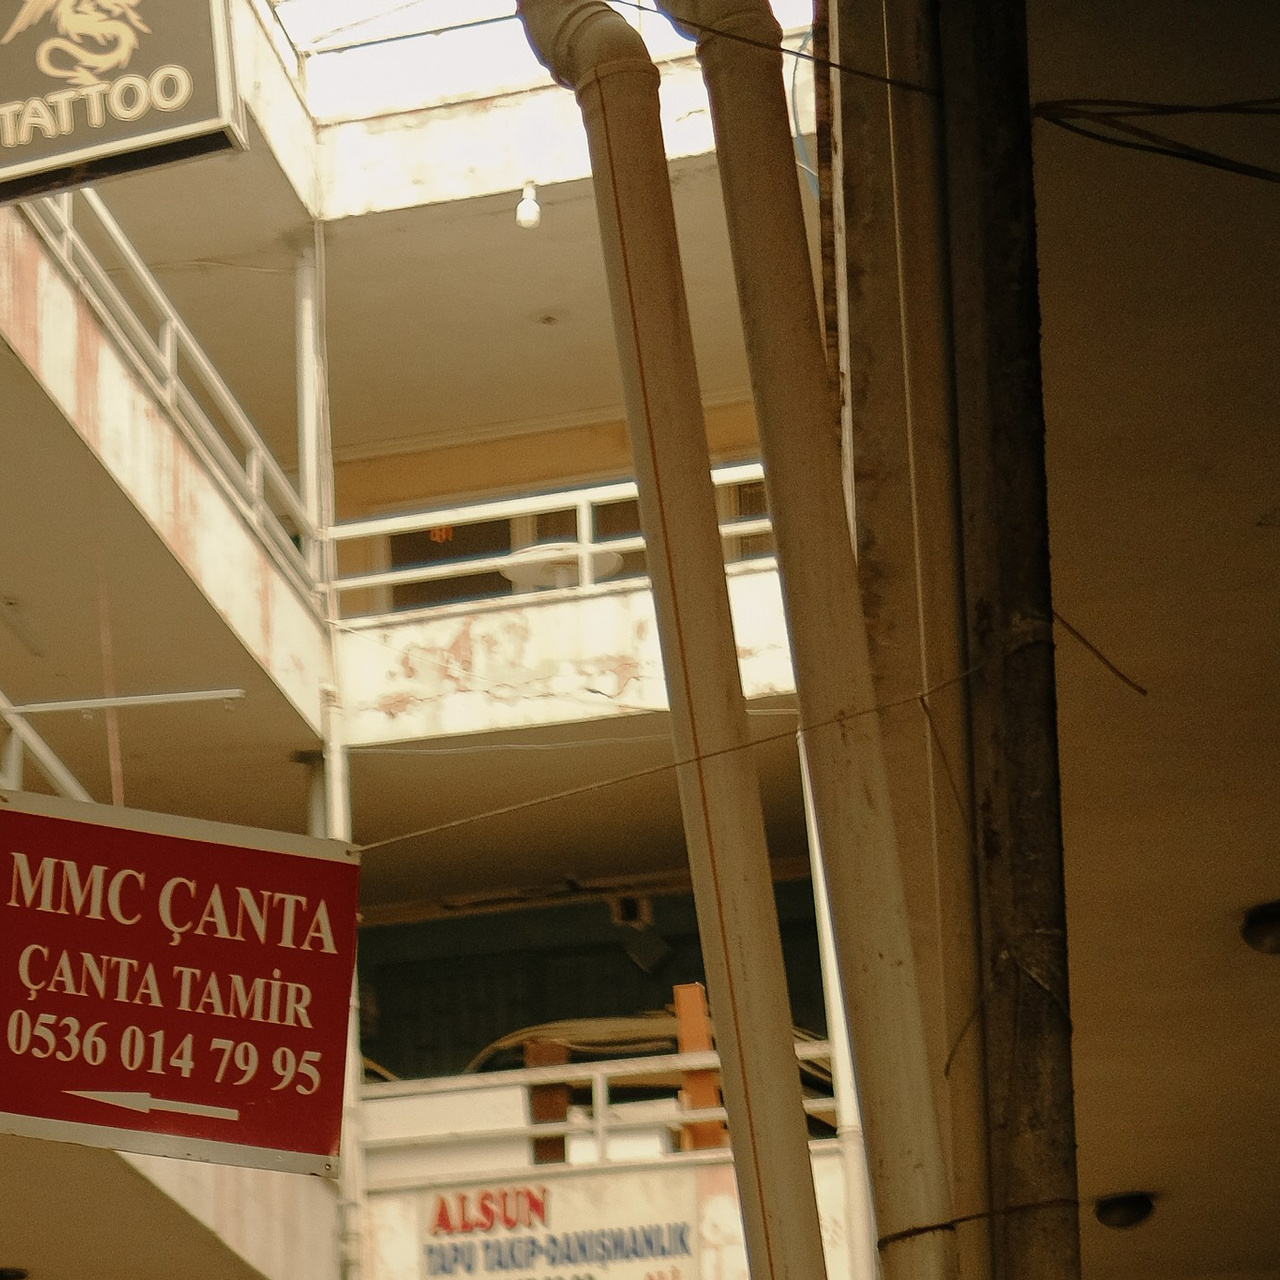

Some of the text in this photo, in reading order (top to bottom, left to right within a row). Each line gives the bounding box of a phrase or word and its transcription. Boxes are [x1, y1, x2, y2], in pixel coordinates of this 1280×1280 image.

[7, 852, 339, 955] MMC ÇANTA
[18, 944, 314, 1029] ÇANTA TAMİR
[7, 1009, 323, 1096] 0536 014 79 95
[430, 1186, 548, 1236] ALSUN
